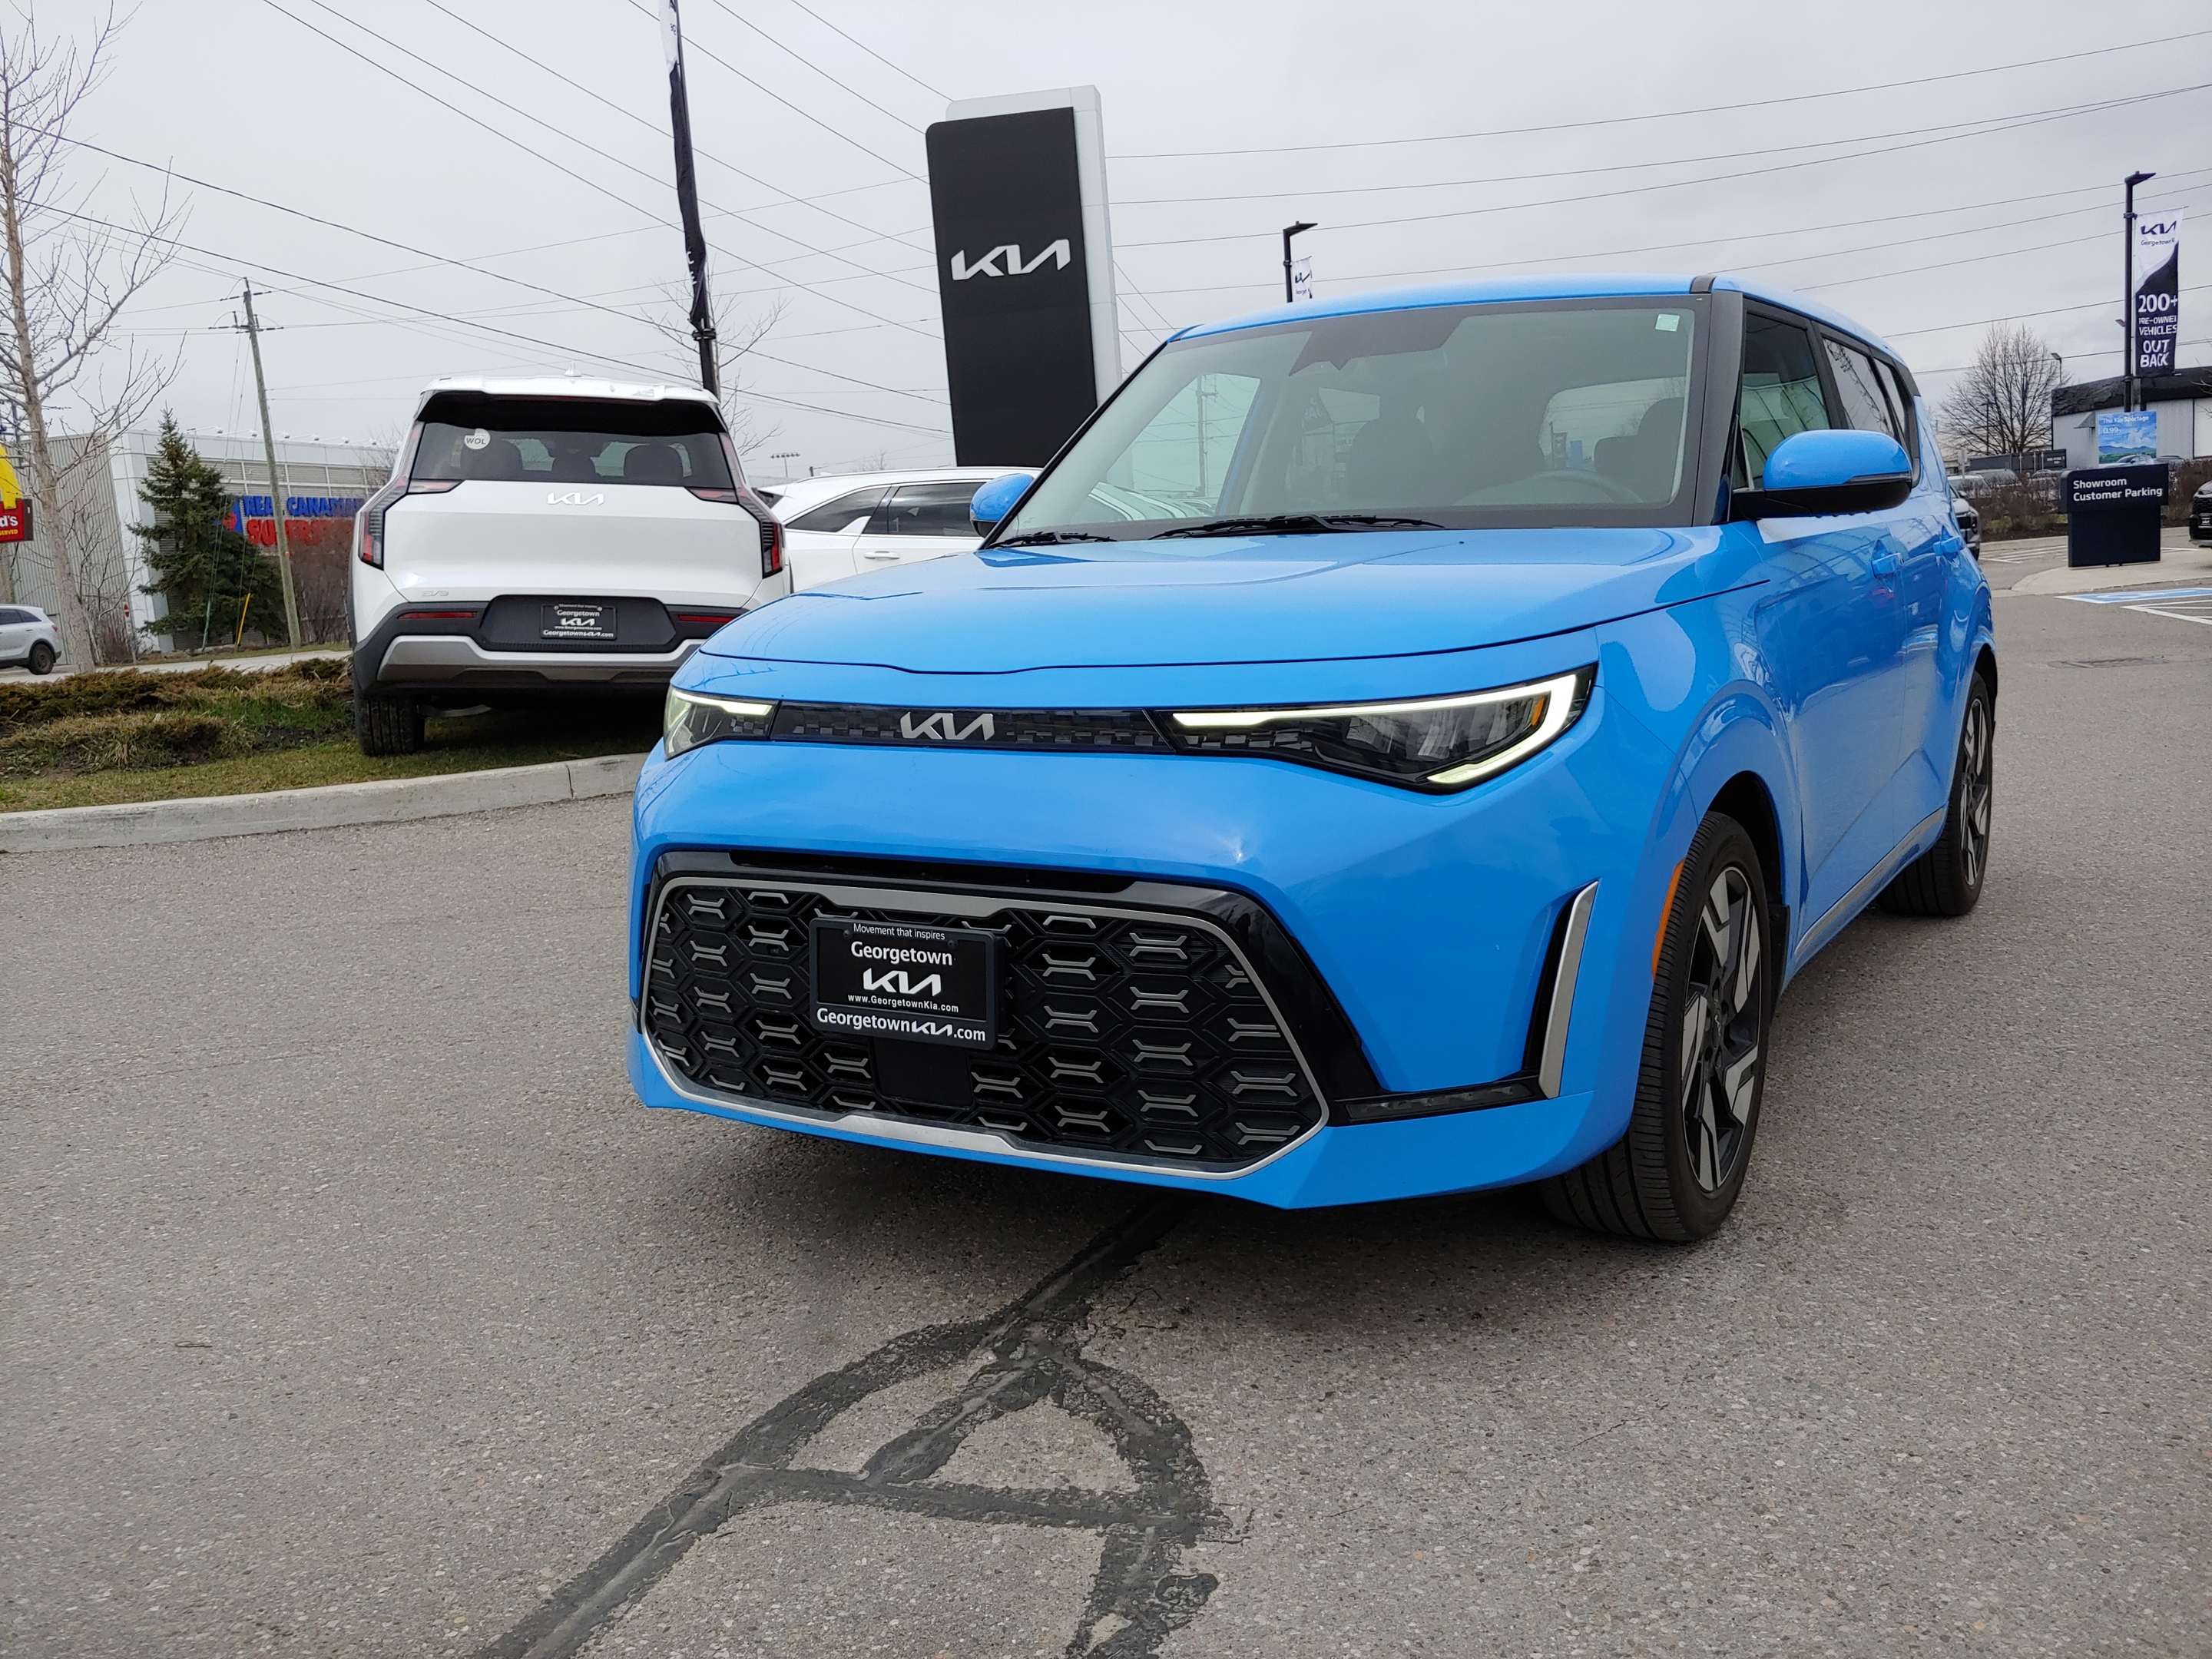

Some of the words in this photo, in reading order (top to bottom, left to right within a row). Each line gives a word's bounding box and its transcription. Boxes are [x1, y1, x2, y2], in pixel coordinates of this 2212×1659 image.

[2140, 220, 2177, 235] KIA
[951, 239, 1071, 281] KIA
[2137, 293, 2178, 313] 200+
[2138, 324, 2178, 336] VEHICLES
[2143, 339, 2170, 353] OUT
[2140, 352, 2170, 368] BACK
[2073, 478, 2127, 489] Showroom
[548, 492, 605, 505] KIA
[2073, 491, 2122, 502] Customer
[2124, 487, 2163, 498] Parking
[557, 609, 601, 618] Georgetown
[561, 618, 595, 627] KIA
[899, 711, 995, 741] KIA
[853, 923, 895, 936] Movement
[896, 927, 912, 938] that
[914, 929, 945, 941] inspires
[851, 941, 952, 965] Georgetown
[863, 967, 942, 997] KIA
[847, 994, 959, 1013] www.GeorgetownKia.com
